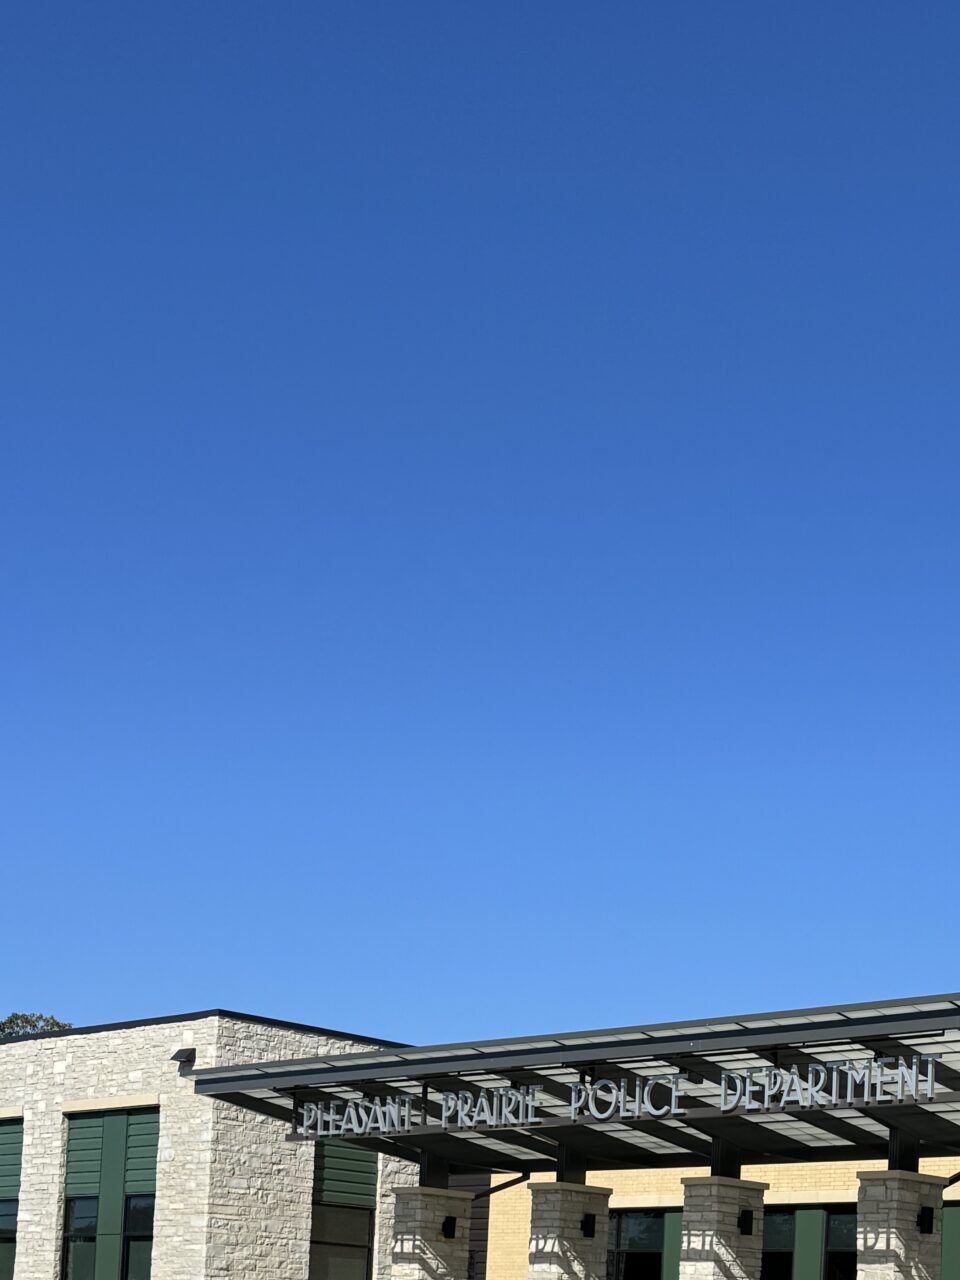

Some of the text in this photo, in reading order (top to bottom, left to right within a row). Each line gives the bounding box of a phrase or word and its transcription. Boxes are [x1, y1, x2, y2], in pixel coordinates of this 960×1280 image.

[302, 1053, 942, 1137] PLEASANT PRAIRIE POLICE DEPARTMENT
